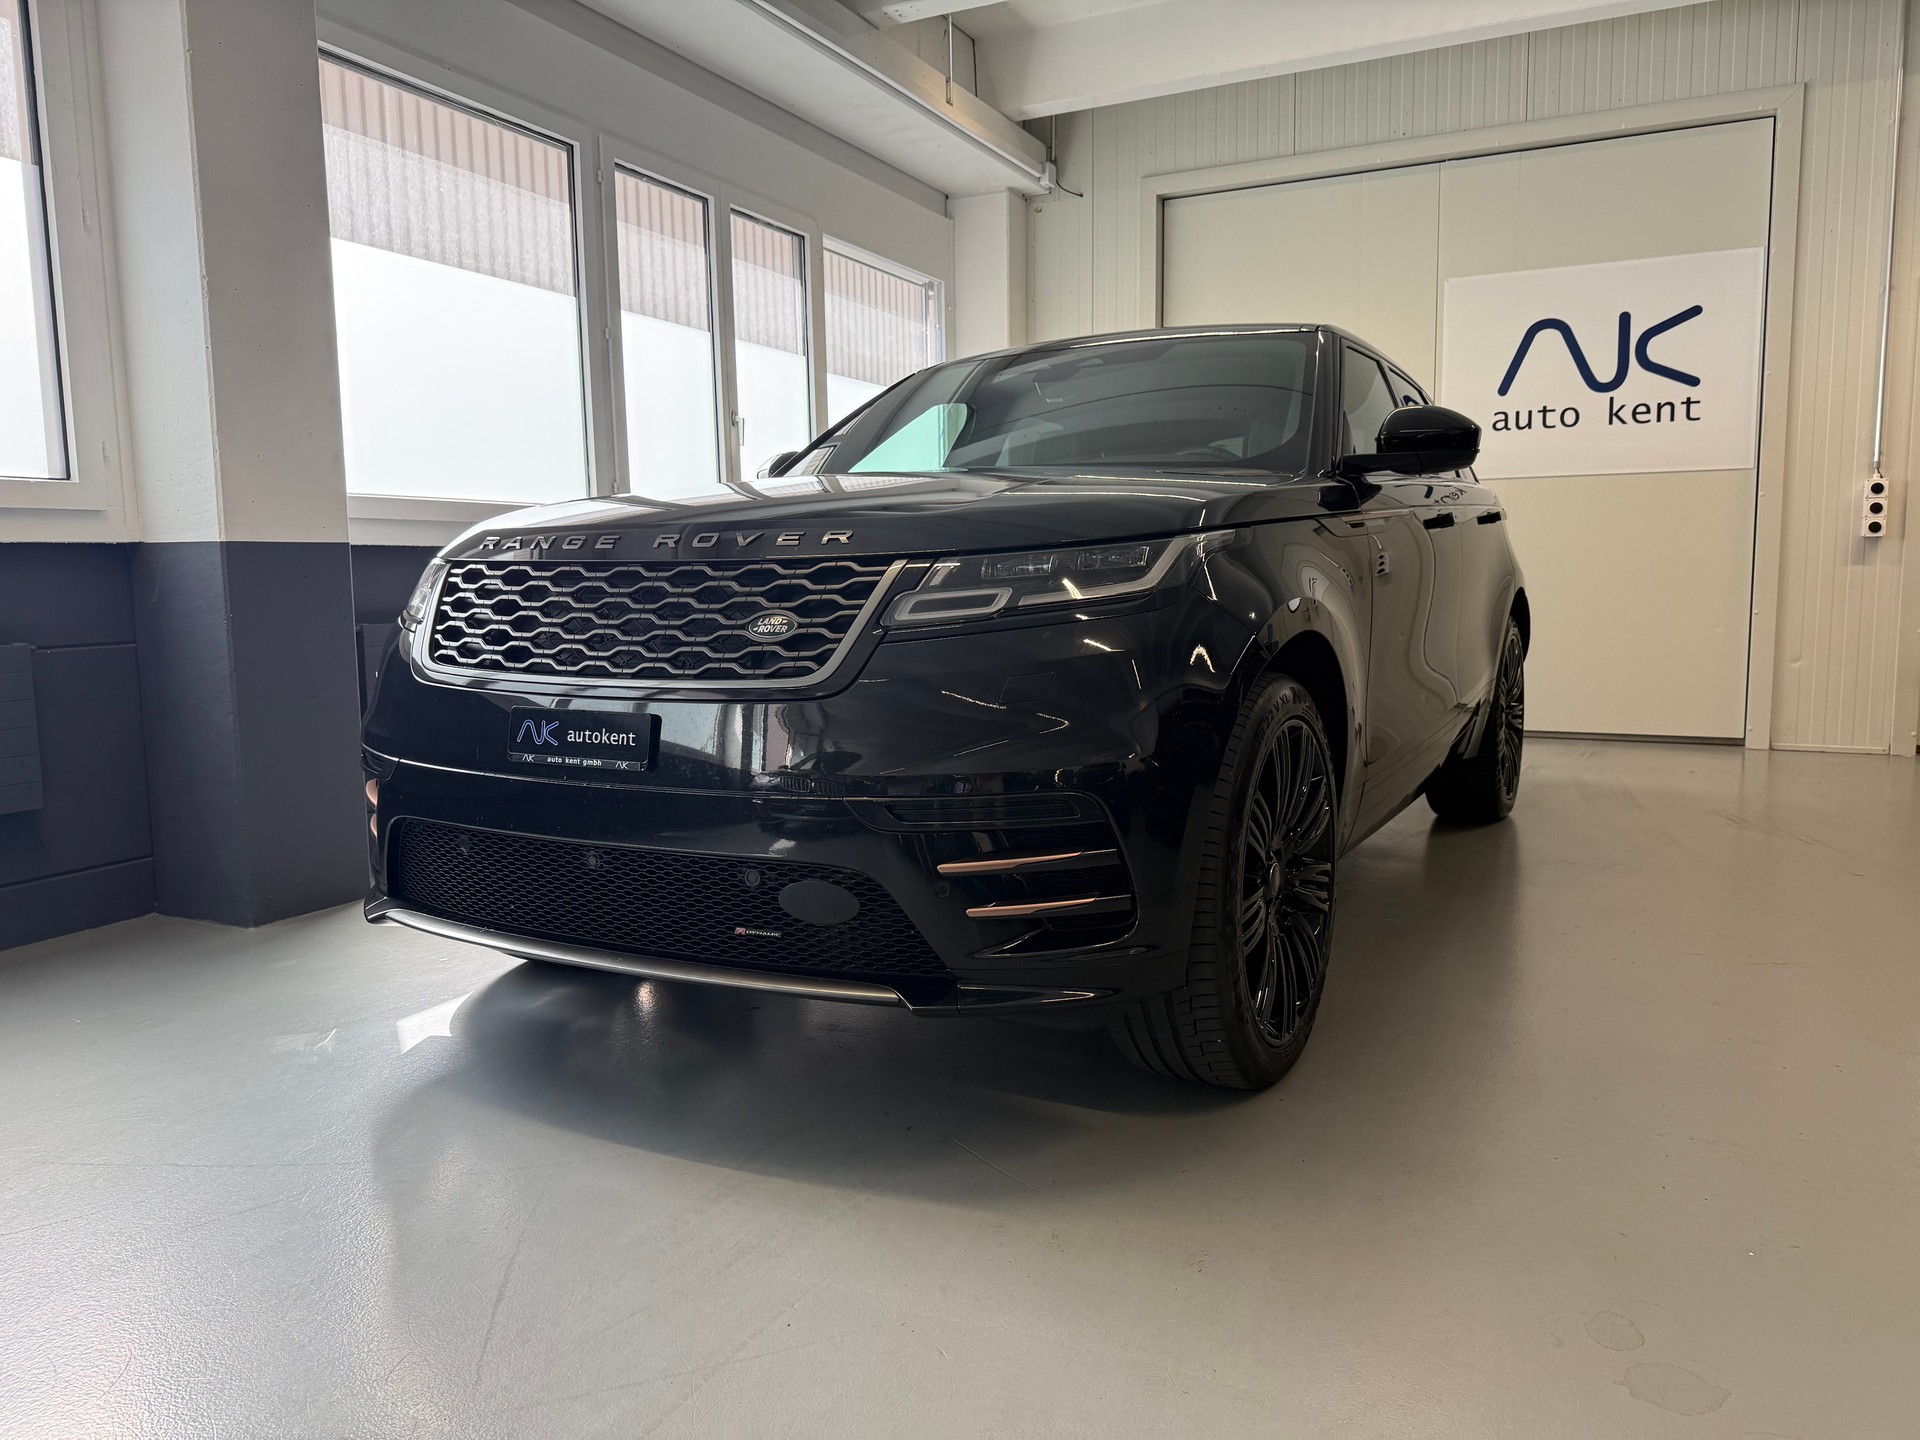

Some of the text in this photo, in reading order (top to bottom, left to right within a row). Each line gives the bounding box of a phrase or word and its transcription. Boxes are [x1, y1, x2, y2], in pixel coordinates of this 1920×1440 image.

[1491, 396, 1701, 432] auto kent
[479, 529, 857, 551] RANGE ROVER
[757, 617, 783, 626] LAND
[757, 625, 788, 633] ROVER
[567, 728, 636, 746] autokent
[565, 757, 580, 765] kent
[582, 758, 601, 767] gmbh
